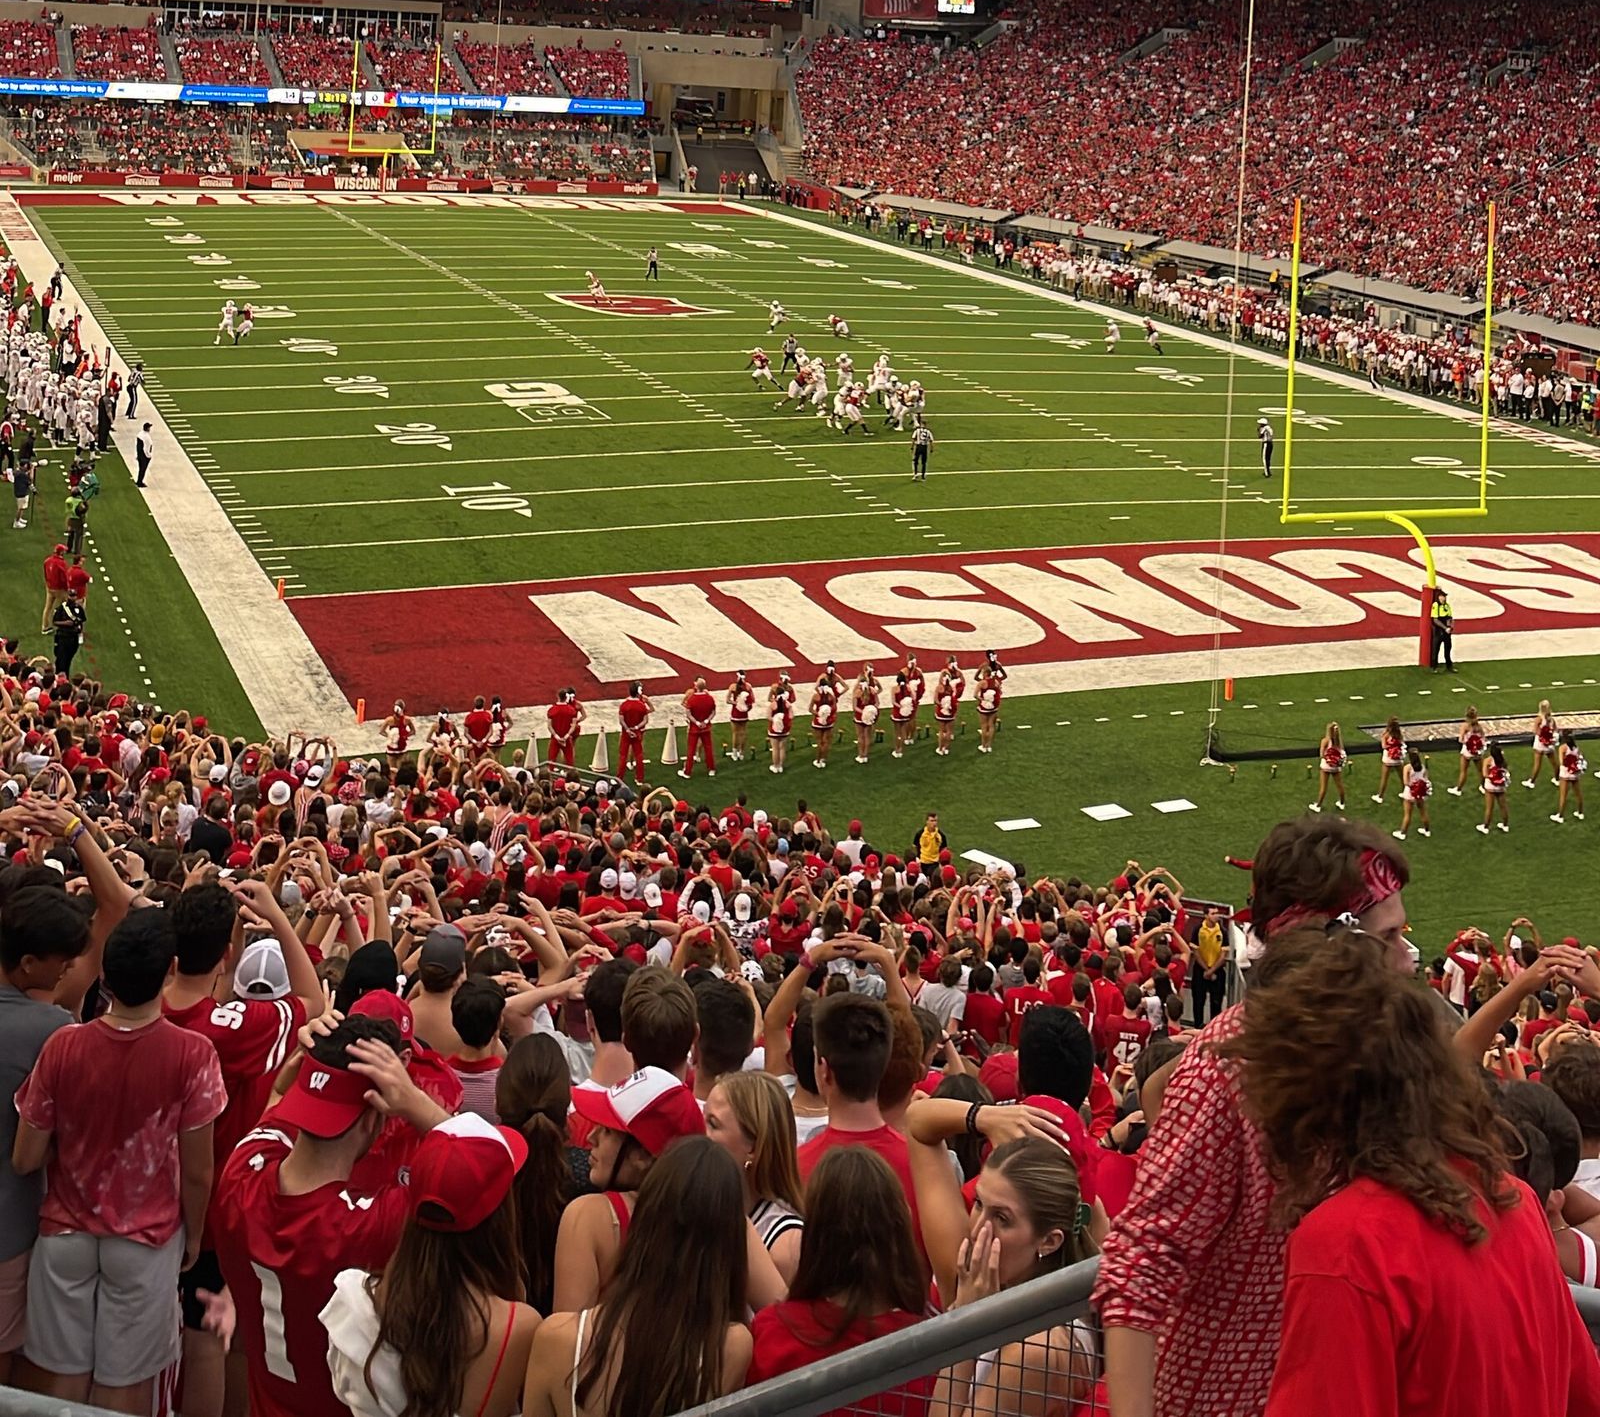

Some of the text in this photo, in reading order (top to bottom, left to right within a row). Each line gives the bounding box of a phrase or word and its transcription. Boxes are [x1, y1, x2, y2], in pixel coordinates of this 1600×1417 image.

[53, 171, 84, 185] meijer
[334, 177, 398, 191] WISCONIN
[623, 183, 648, 195] meijer
[374, 422, 451, 446] 20
[440, 481, 531, 511] 10
[1112, 1041, 1141, 1064] 42
[309, 1071, 331, 1092] W
